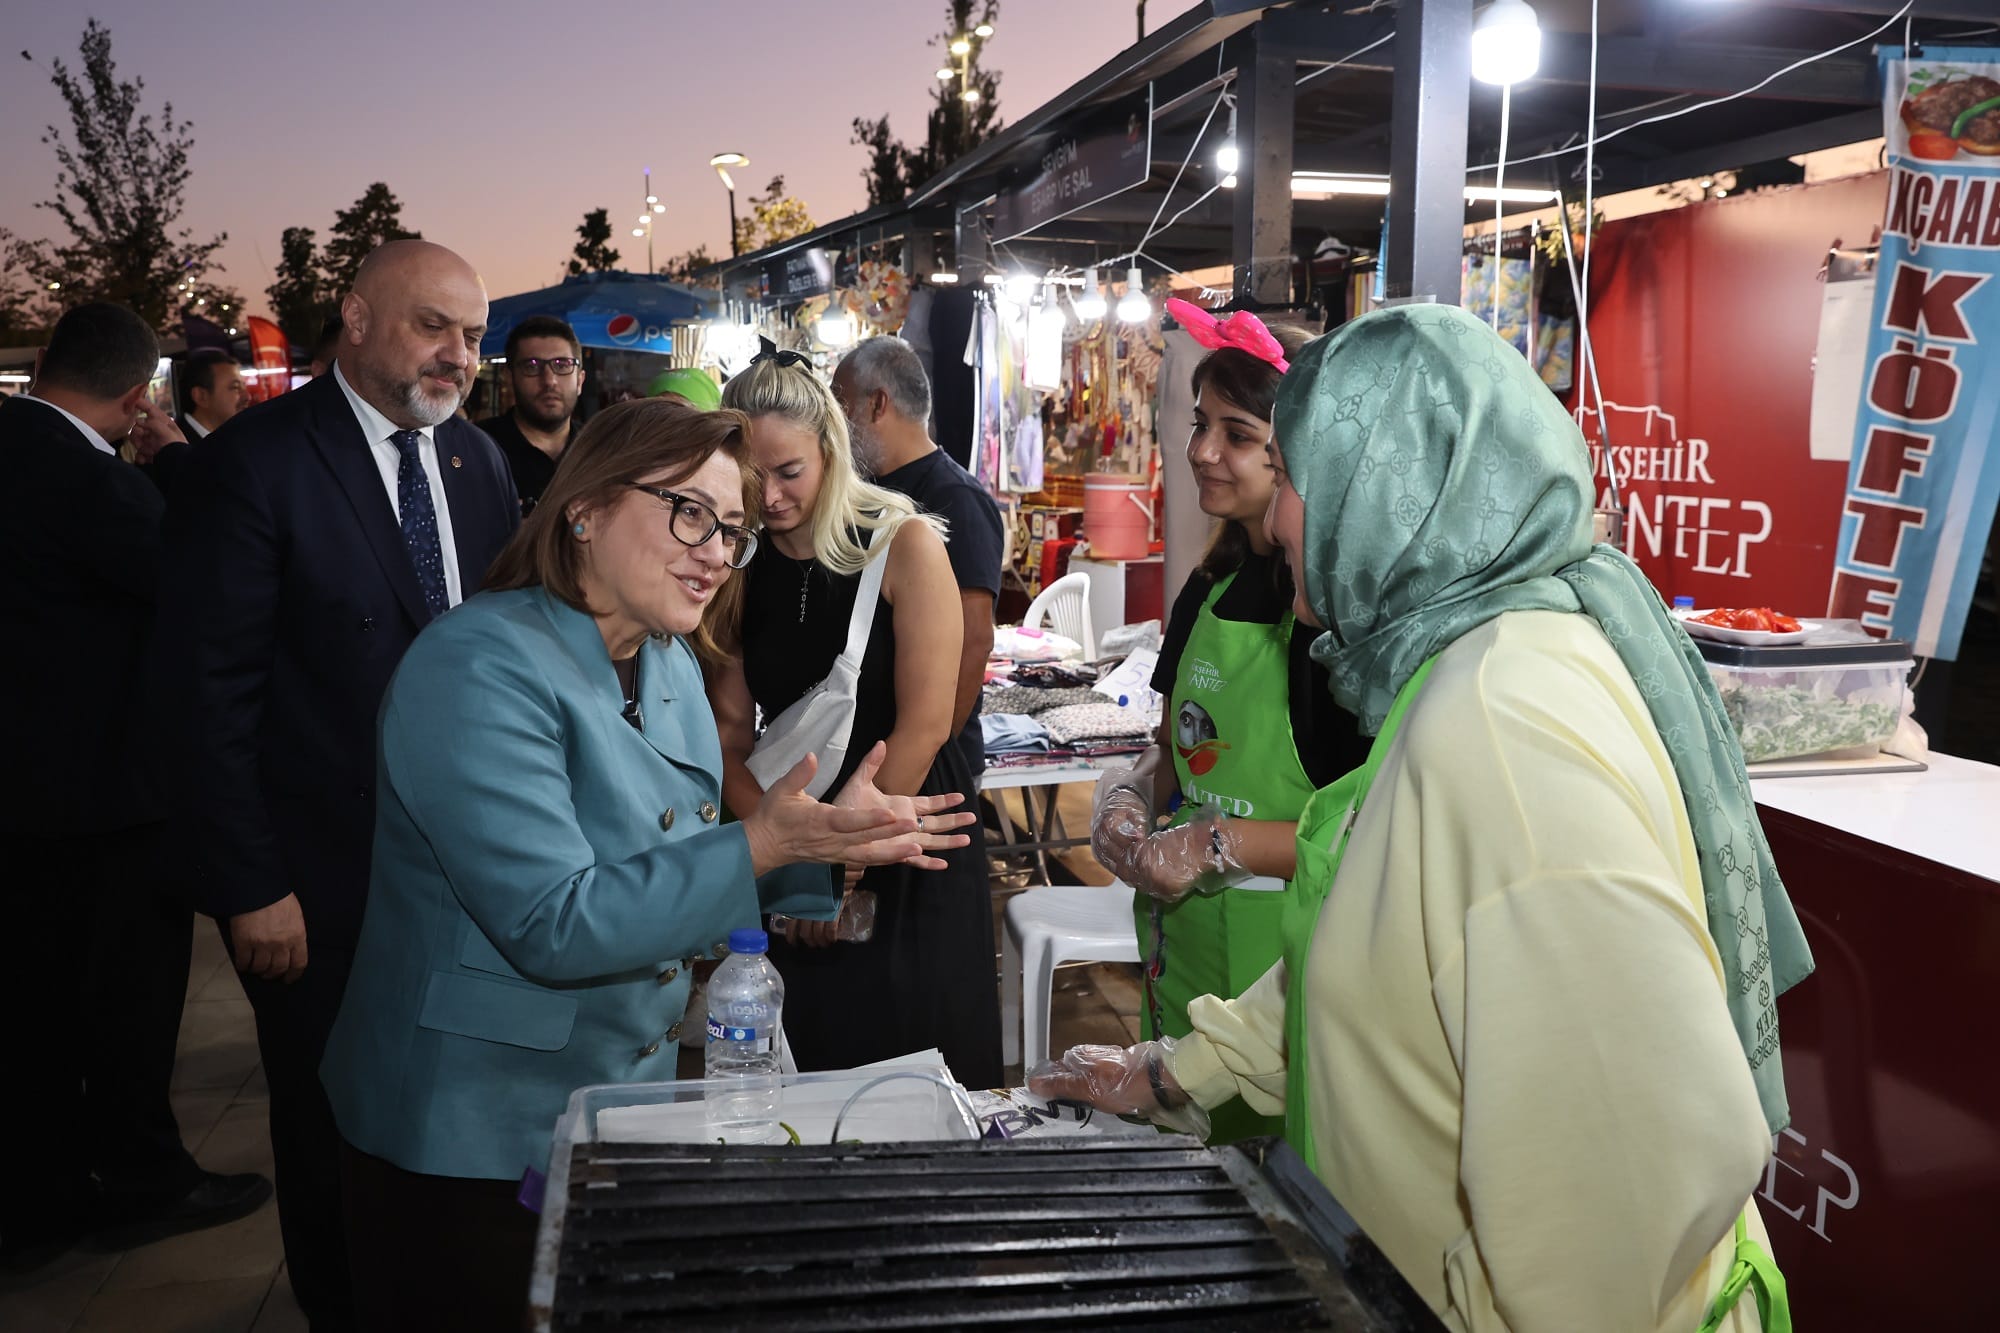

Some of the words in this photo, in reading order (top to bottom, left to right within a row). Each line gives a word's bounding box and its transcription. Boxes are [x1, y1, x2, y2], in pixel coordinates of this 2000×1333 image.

[1057, 173, 1071, 200] VE
[1072, 166, 1093, 198] ŞAL
[644, 326, 673, 344] pe
[1827, 262, 1992, 640] KÖFTE
